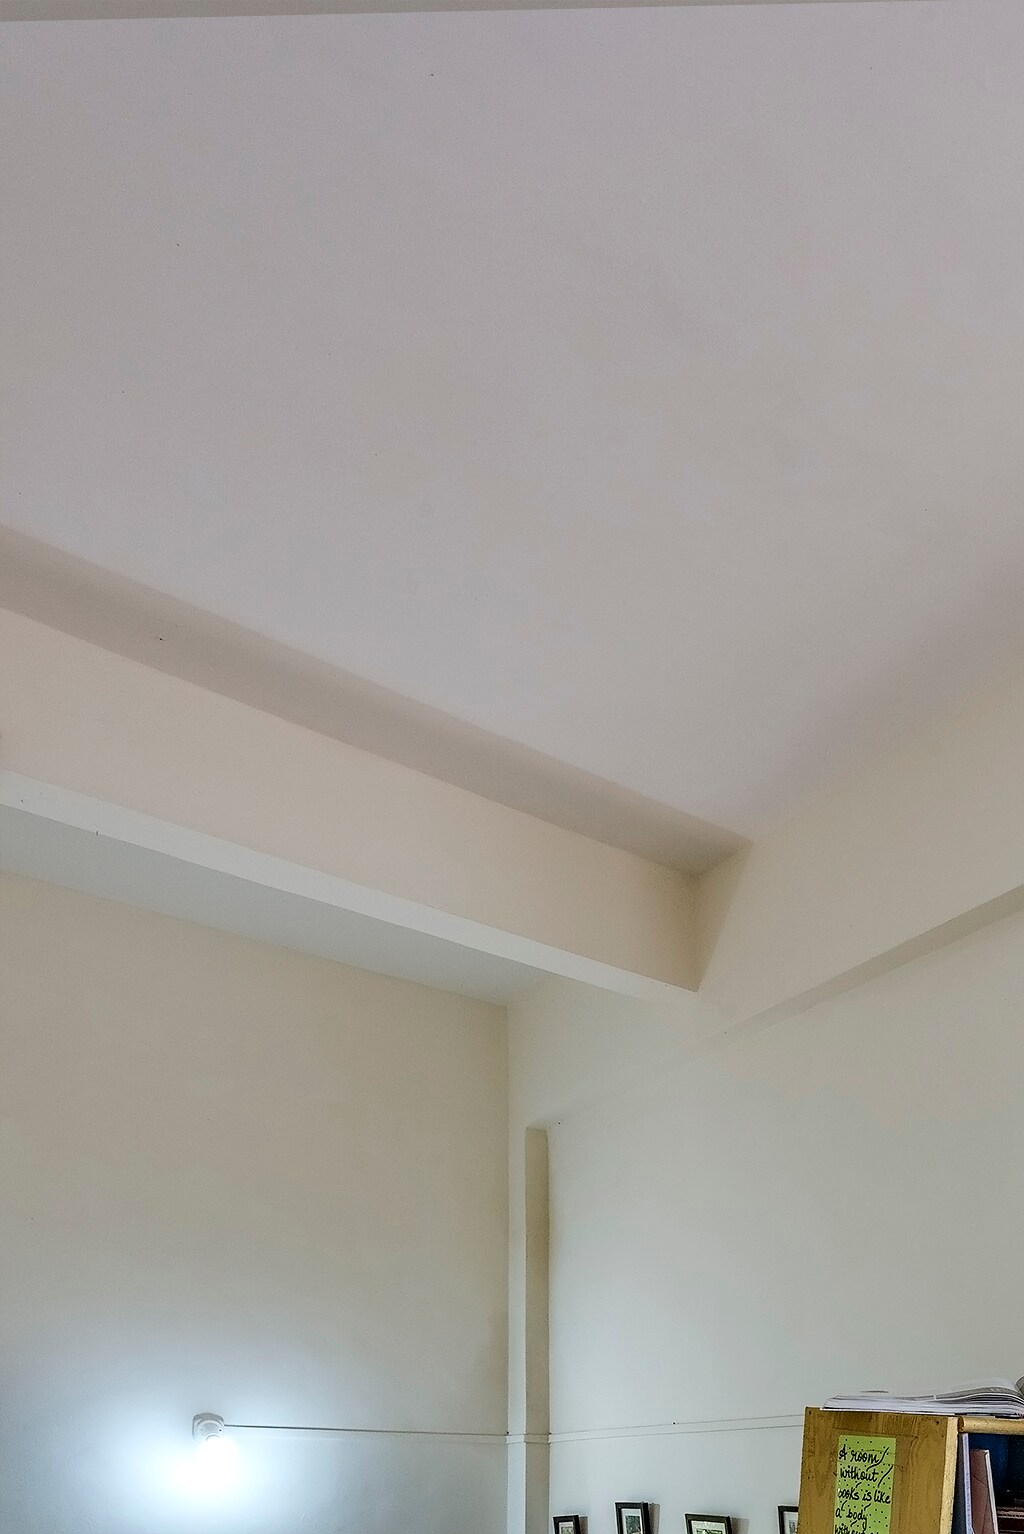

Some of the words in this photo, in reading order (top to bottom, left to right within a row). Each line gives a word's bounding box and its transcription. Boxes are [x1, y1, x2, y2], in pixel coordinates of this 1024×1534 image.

[838, 1444, 848, 1461] A
[850, 1451, 879, 1464] room
[840, 1467, 879, 1483] without
[838, 1487, 860, 1501] books
[862, 1489, 873, 1502] is
[874, 1489, 891, 1505] like
[845, 1508, 868, 1531] body
